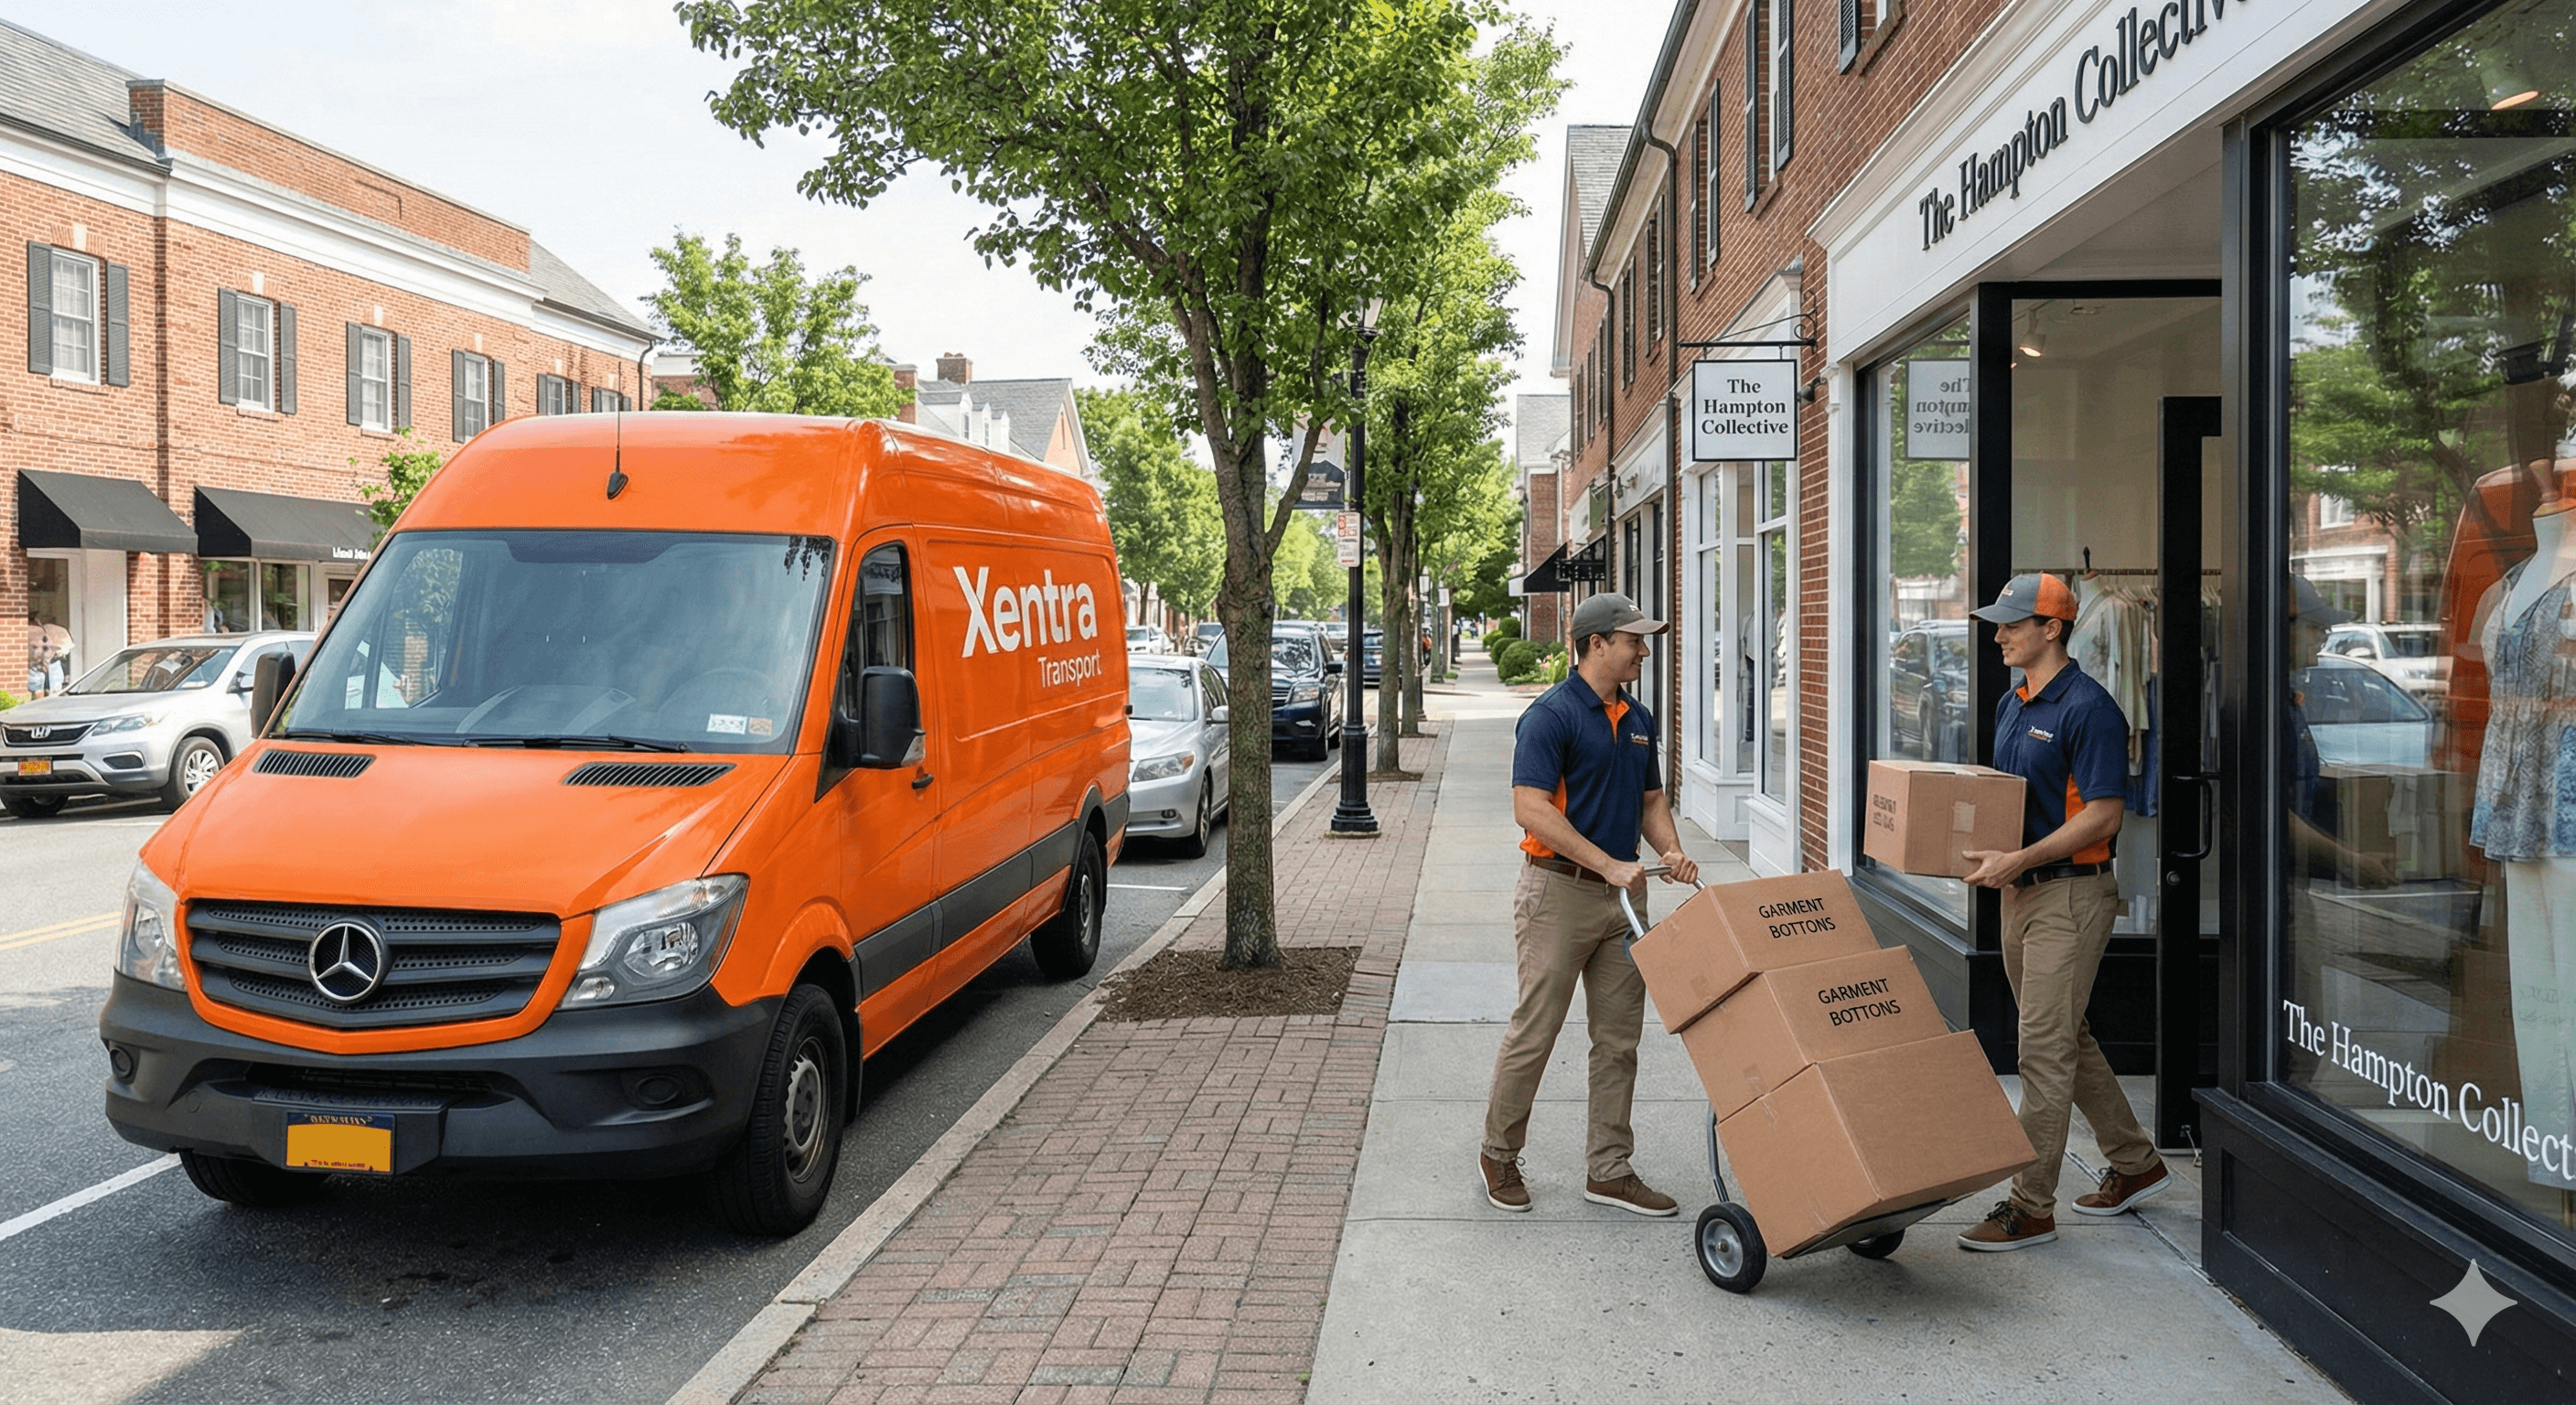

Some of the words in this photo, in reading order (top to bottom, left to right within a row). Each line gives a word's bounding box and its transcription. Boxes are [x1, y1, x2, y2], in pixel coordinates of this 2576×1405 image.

[1919, 188, 1955, 251] The
[1959, 96, 2068, 221] Hampton
[1726, 379, 1761, 393] The
[1703, 399, 1787, 418] Hampton
[1701, 419, 1788, 434] Collective
[952, 565, 1098, 658] Xentra
[1037, 649, 1101, 688] Transport
[1758, 897, 1825, 918] GARMENT
[1769, 917, 1836, 938] BOTTONS
[1818, 978, 1890, 1004] GARMENT
[1829, 999, 1901, 1026] BOTTONS
[2283, 999, 2325, 1056] The
[2331, 1021, 2451, 1121] Hampton
[2459, 1082, 2576, 1181] Collect
